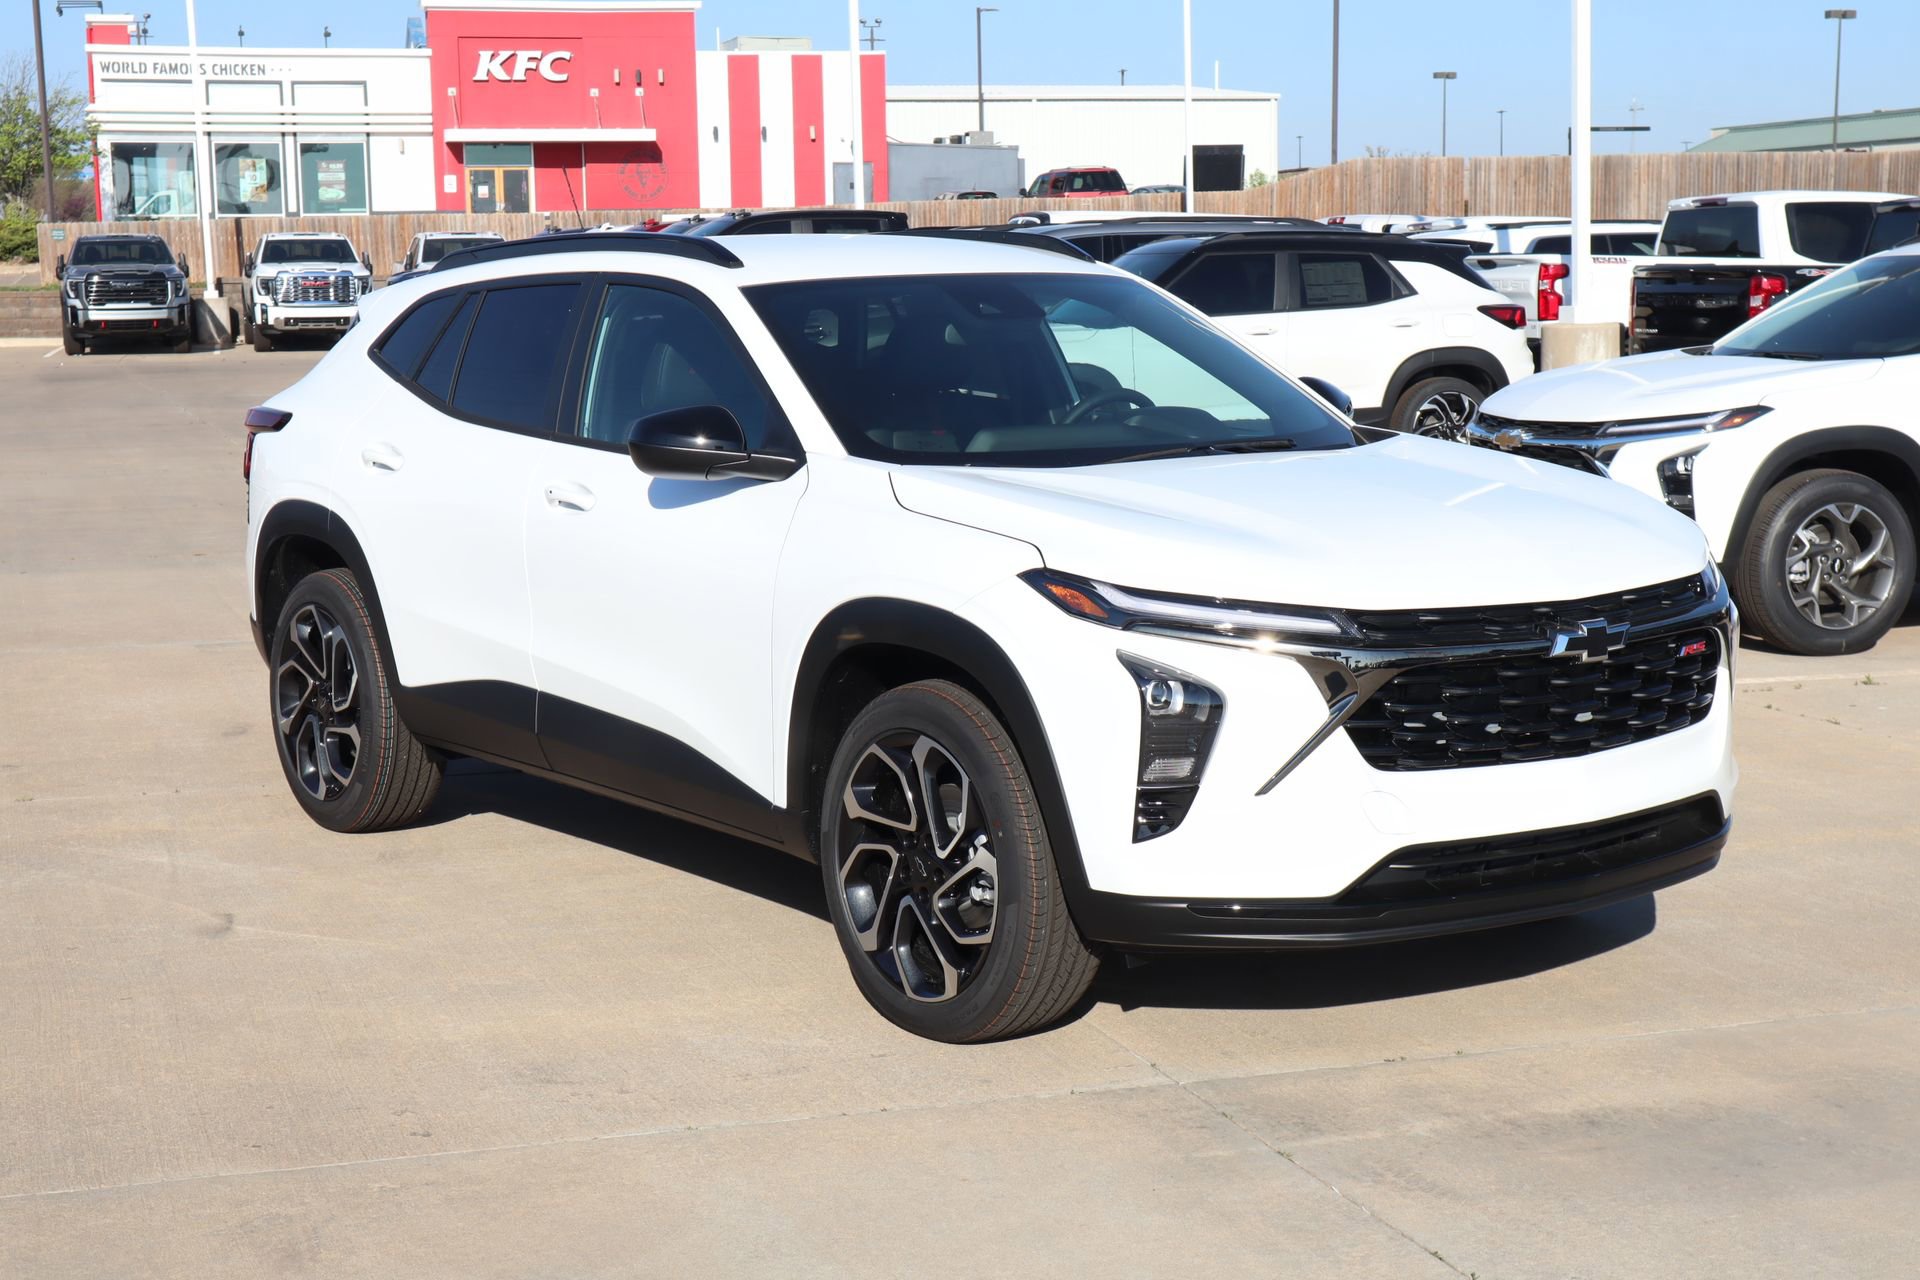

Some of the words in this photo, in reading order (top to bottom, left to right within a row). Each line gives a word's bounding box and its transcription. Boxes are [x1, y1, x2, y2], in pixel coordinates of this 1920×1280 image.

[100, 61, 148, 75] WORLD
[153, 62, 207, 76] FAMOS
[212, 63, 266, 76] CHICKEN
[472, 50, 572, 82] KFC
[1681, 641, 1706, 656] RS
